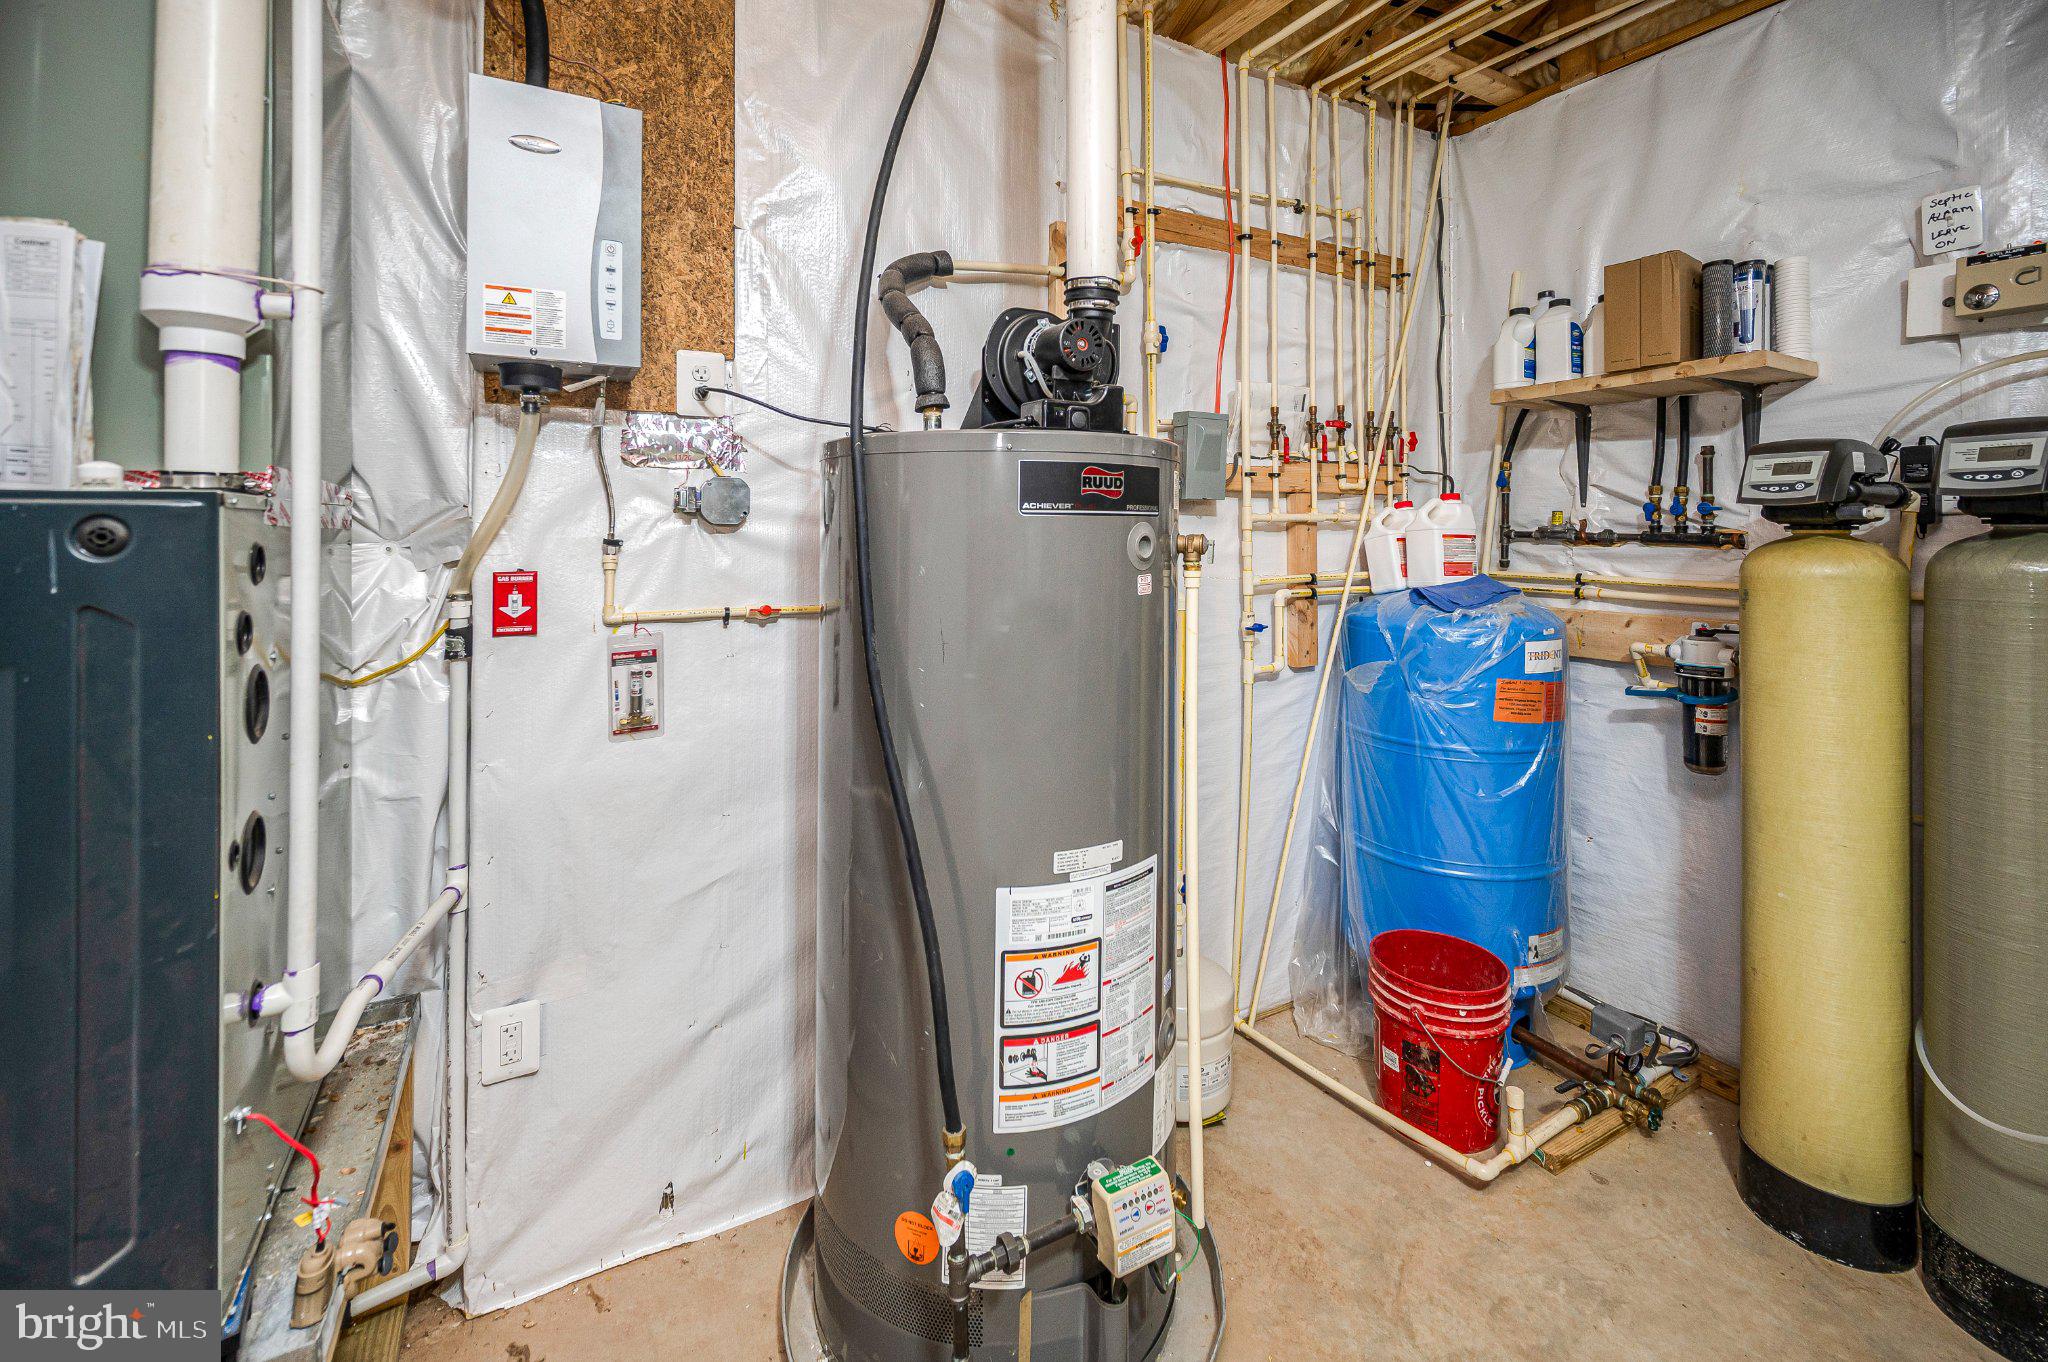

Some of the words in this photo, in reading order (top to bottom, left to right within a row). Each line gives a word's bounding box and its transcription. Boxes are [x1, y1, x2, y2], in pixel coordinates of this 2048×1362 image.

[1935, 238, 1957, 249] ON
[1082, 476, 1124, 490] RUUD
[1022, 502, 1072, 510] ACHIEVER
[1126, 504, 1158, 512] PROFESSIONAL
[1041, 949, 1076, 960] WARNING
[1039, 1033, 1069, 1045] DANGER
[1041, 1087, 1071, 1099] WARNING
[1477, 1087, 1494, 1128] PICKLE
